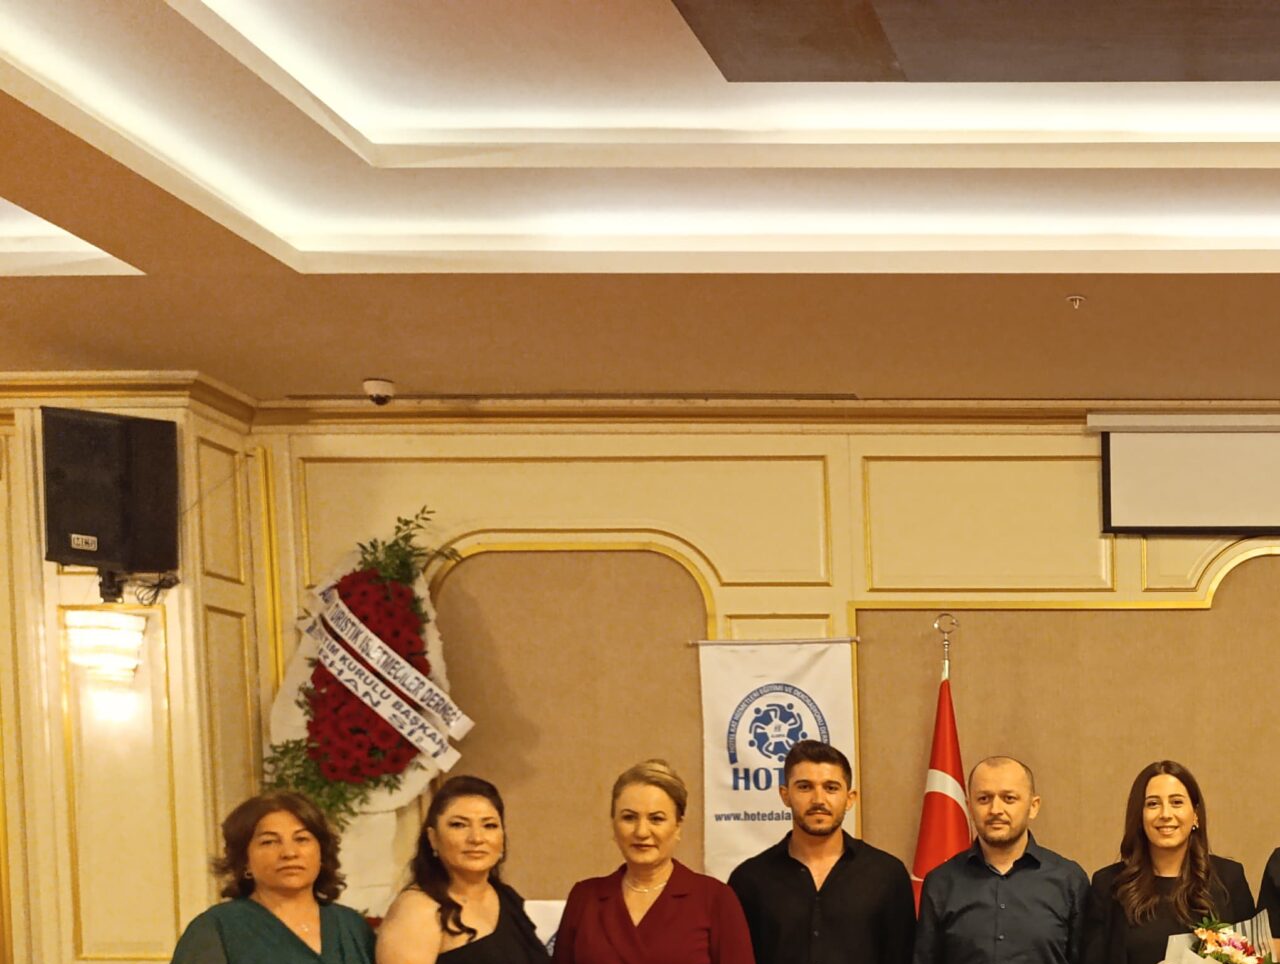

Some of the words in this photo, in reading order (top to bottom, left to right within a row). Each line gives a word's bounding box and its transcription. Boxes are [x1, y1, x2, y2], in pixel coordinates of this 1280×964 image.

[318, 647, 381, 708] RHAN
[339, 654, 391, 700] KURULU
[732, 767, 786, 791] HOT
[715, 811, 792, 821] www.hotedala
